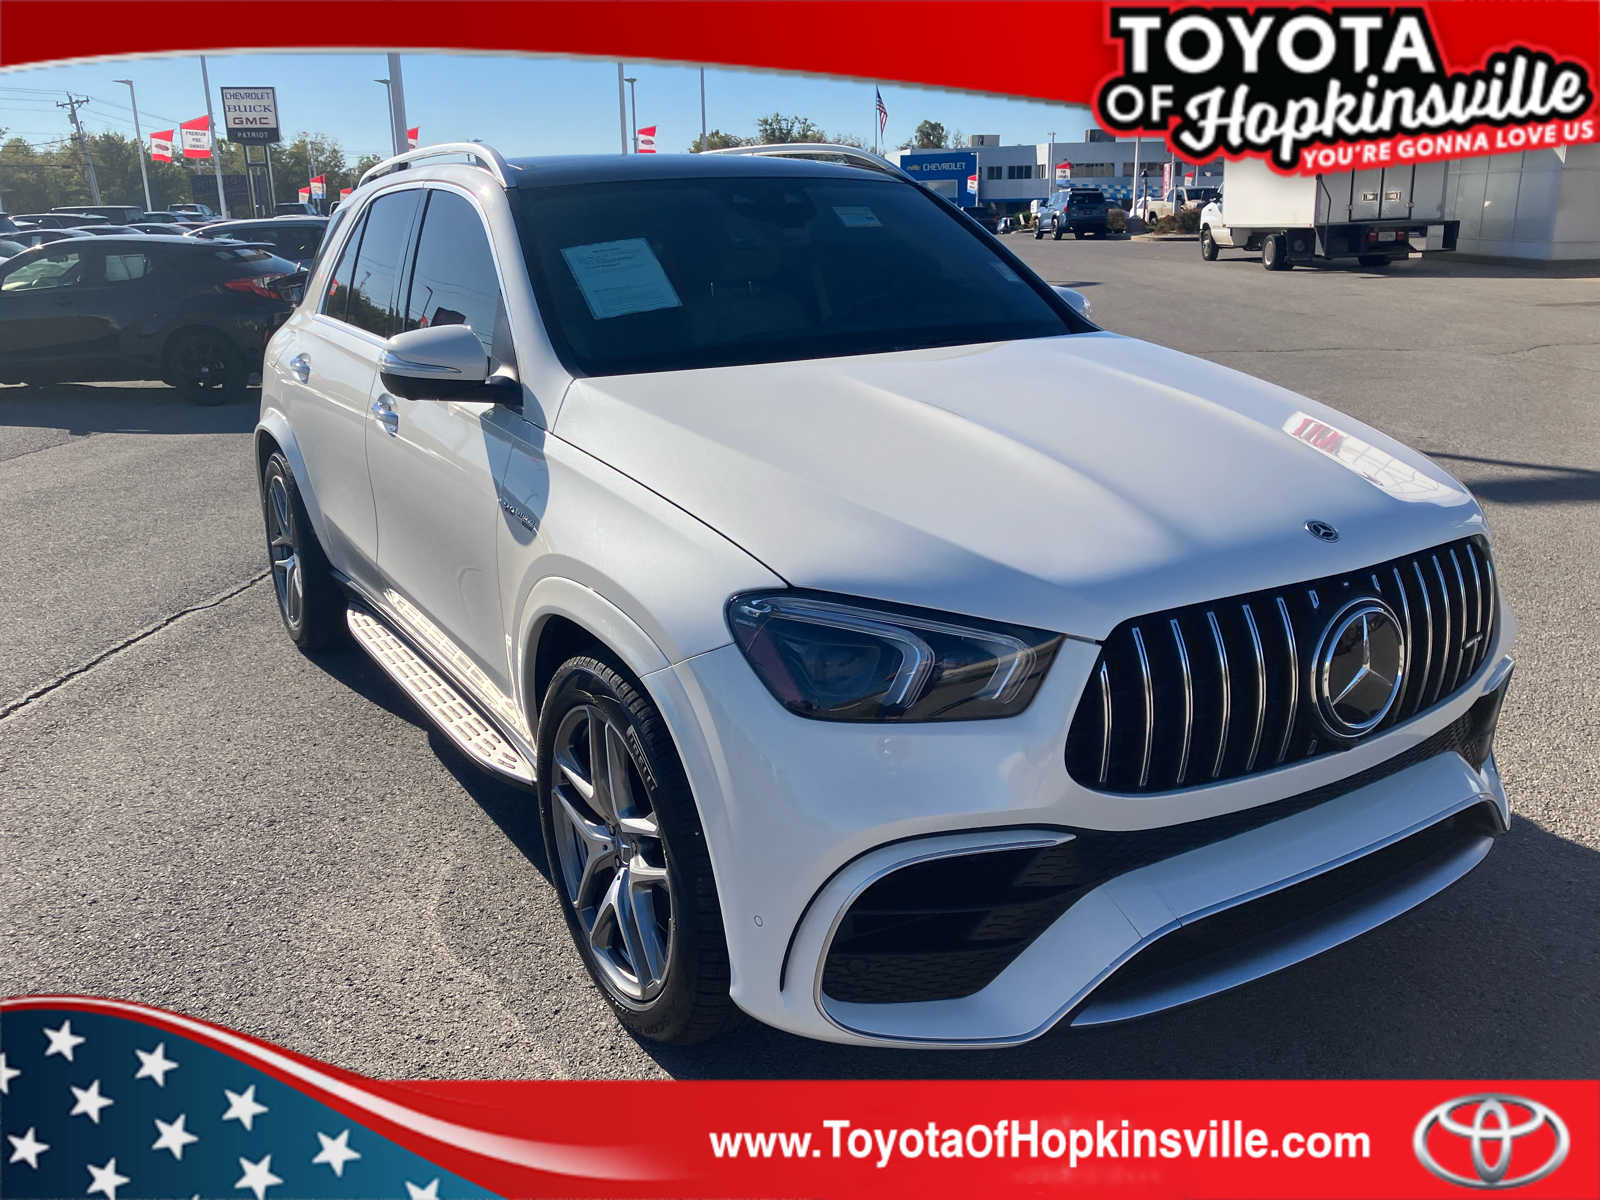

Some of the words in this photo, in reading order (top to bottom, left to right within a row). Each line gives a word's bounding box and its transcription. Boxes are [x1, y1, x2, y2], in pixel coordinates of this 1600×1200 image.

[225, 92, 271, 100] CHEVROLET
[227, 104, 273, 113] BUICK
[233, 117, 270, 125] GMC
[237, 131, 268, 139] PATRIOT
[922, 162, 966, 171] CHEVROLET
